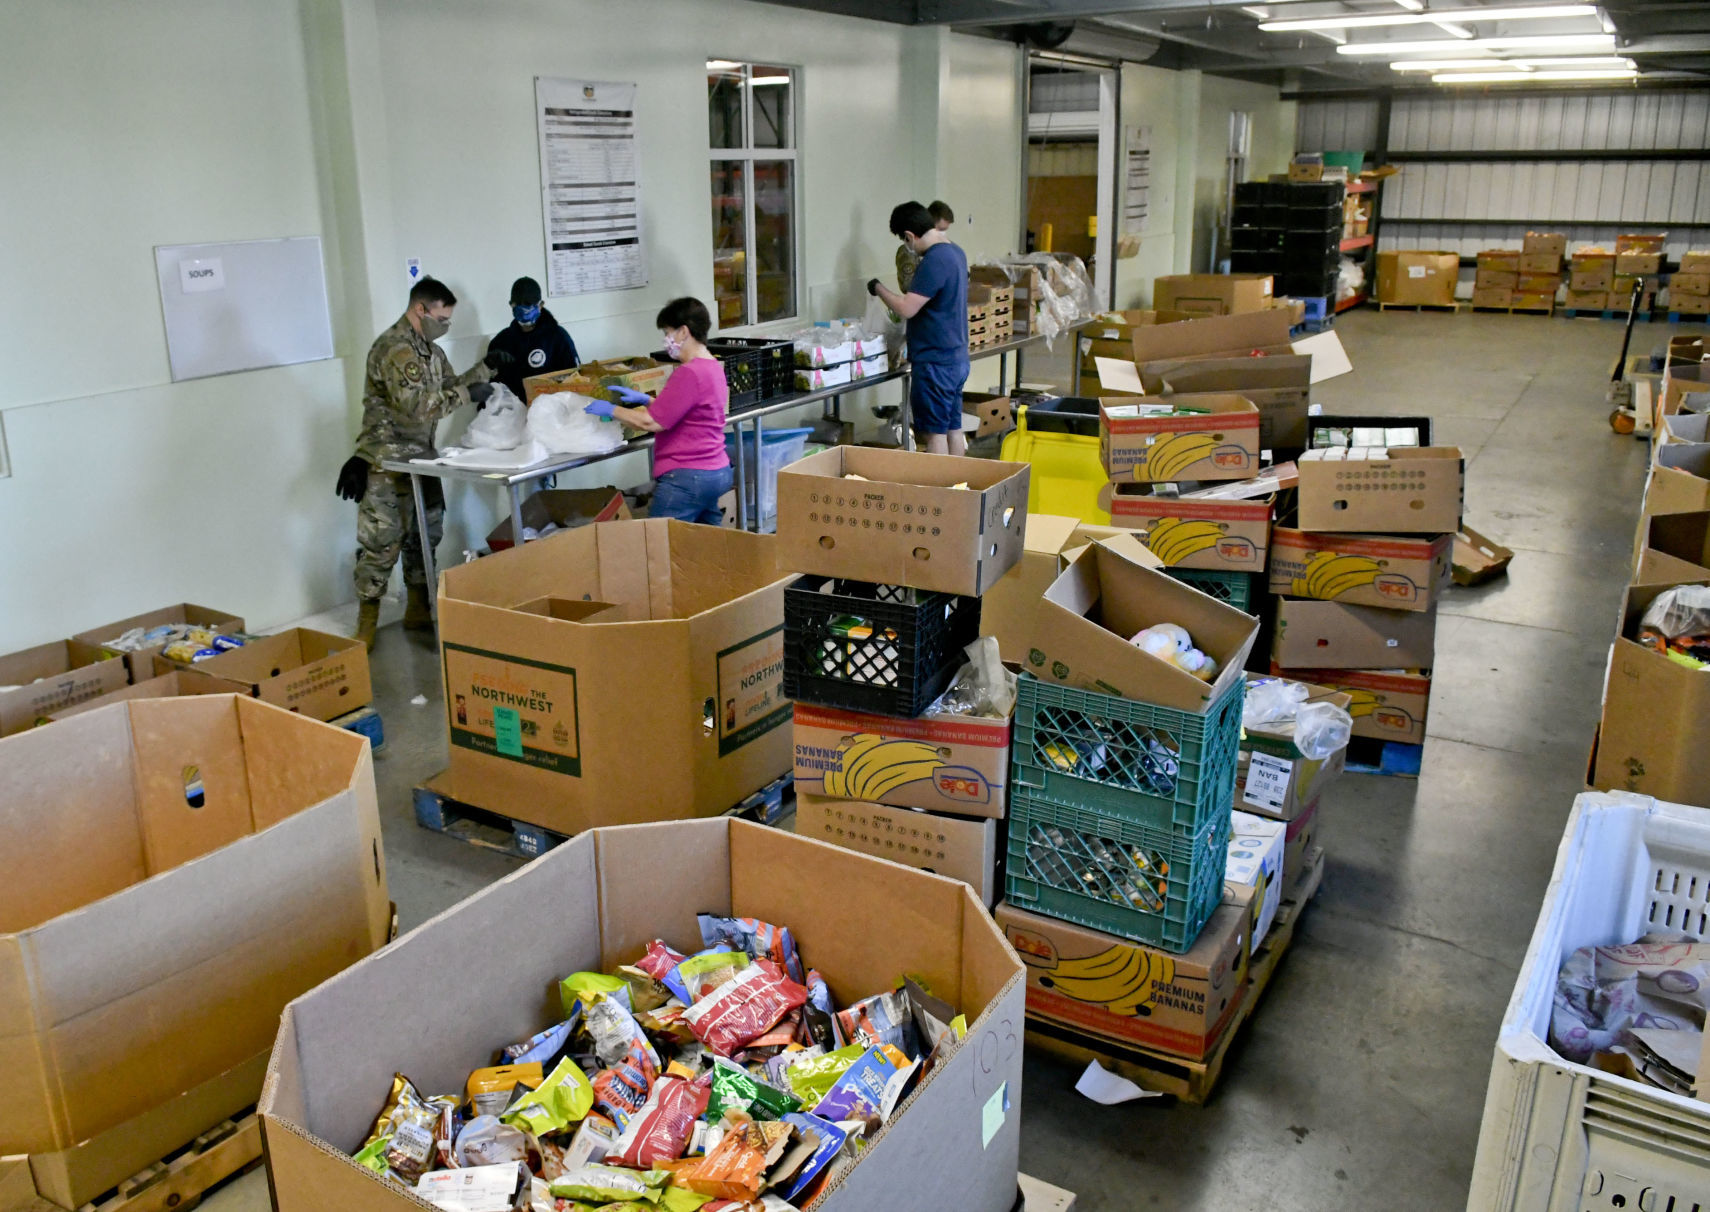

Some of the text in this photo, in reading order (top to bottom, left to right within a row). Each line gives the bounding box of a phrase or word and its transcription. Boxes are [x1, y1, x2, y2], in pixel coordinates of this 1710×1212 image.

[189, 269, 214, 279] SOUPS
[1215, 454, 1242, 465] Dole
[1220, 546, 1249, 557] Dole
[1379, 583, 1409, 596] Dole
[741, 660, 784, 690] NORTHW
[472, 685, 553, 713] NORTHWEST
[531, 690, 546, 699] THE
[479, 719, 495, 728] LIFE
[472, 737, 497, 751] Partner
[796, 745, 843, 760] BANANAS
[796, 756, 843, 772] PREMIUM
[1258, 769, 1279, 781] BAN
[940, 779, 978, 796] Dole
[1015, 934, 1052, 957] Dole
[1152, 980, 1205, 1003] PREMIUM
[1150, 992, 1204, 1015] BANANAS
[861, 1071, 884, 1101] TREATS
